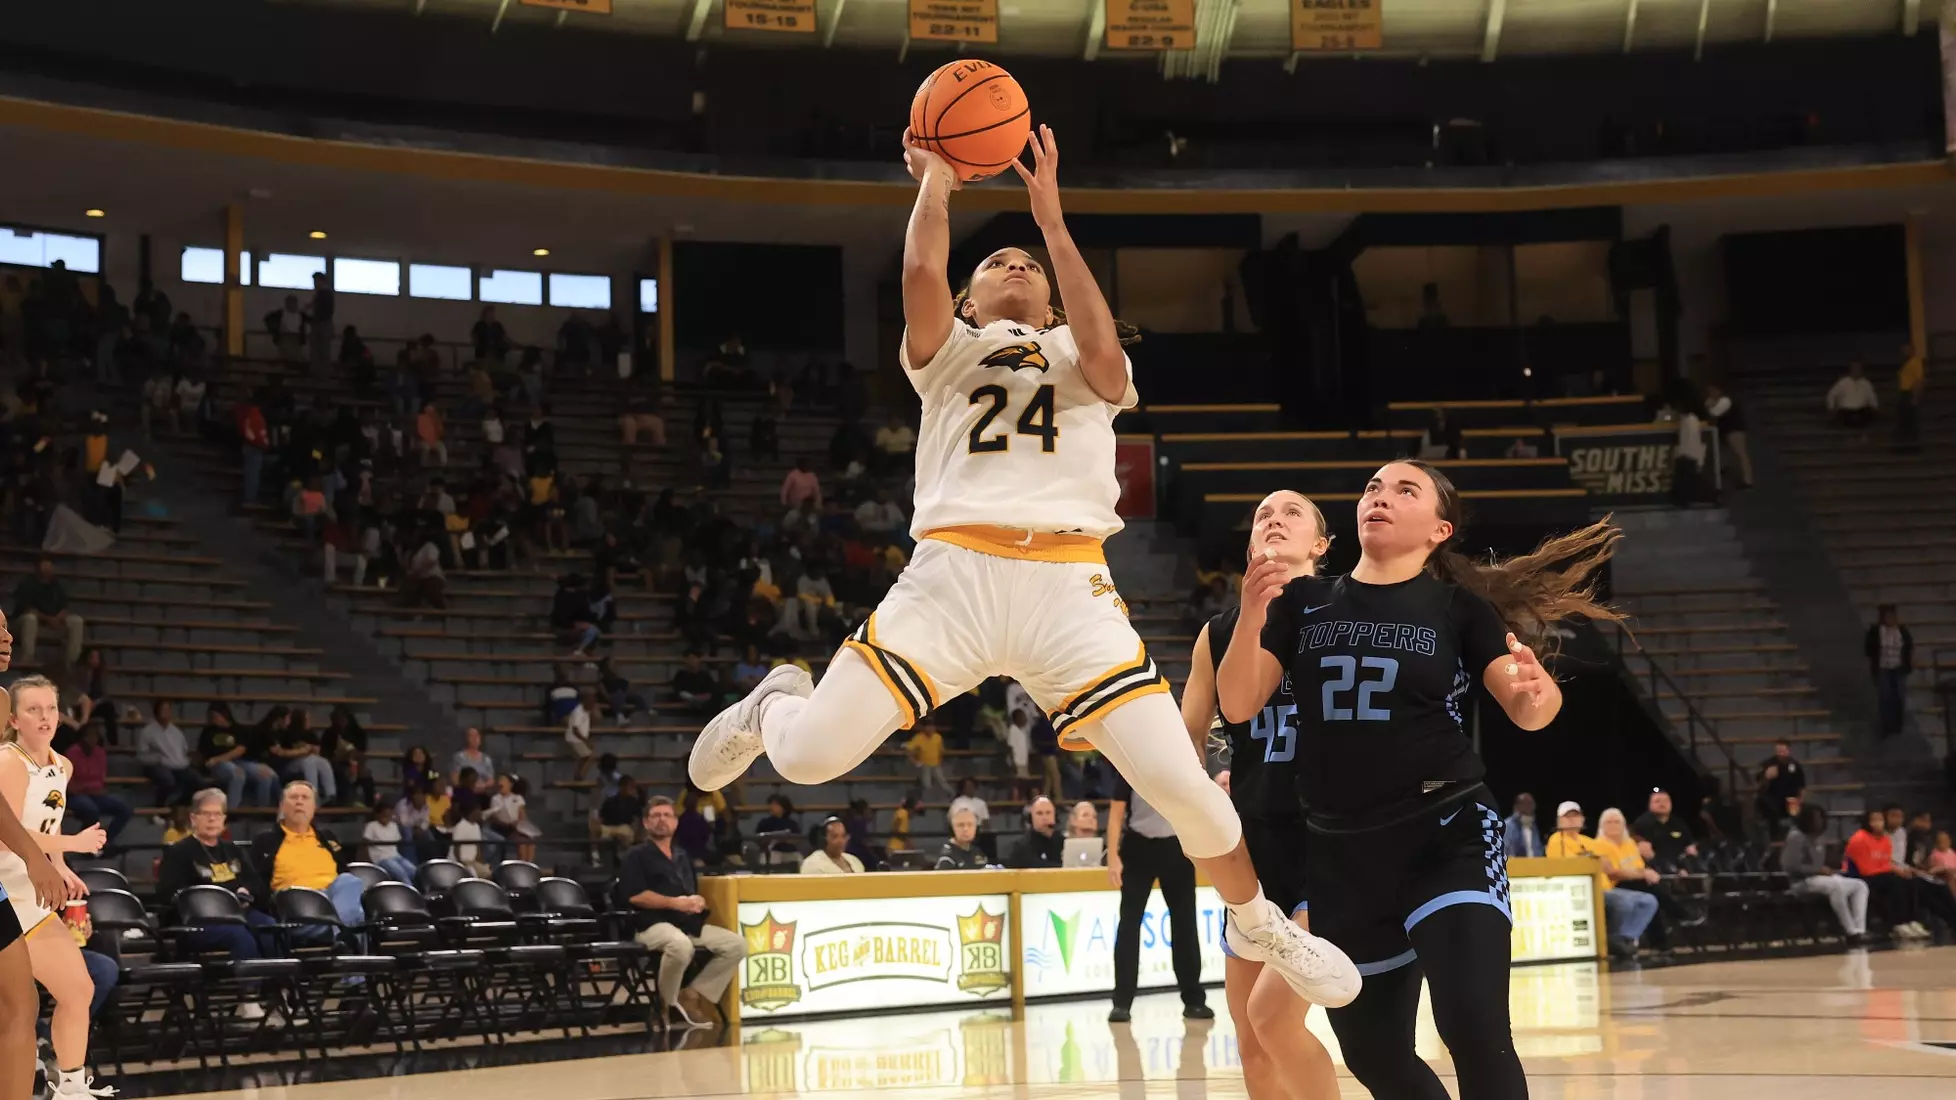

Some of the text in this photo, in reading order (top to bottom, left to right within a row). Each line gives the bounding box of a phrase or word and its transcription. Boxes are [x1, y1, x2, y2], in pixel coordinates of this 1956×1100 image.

[968, 383, 1060, 456] 24
[1570, 445, 1671, 473] SOUTHE
[1607, 471, 1662, 493] MISS
[1299, 621, 1436, 656] TOPPERS
[1320, 655, 1399, 721] 22
[1250, 704, 1298, 763] 45
[815, 940, 848, 973] KEG
[872, 936, 940, 966] BARREL
